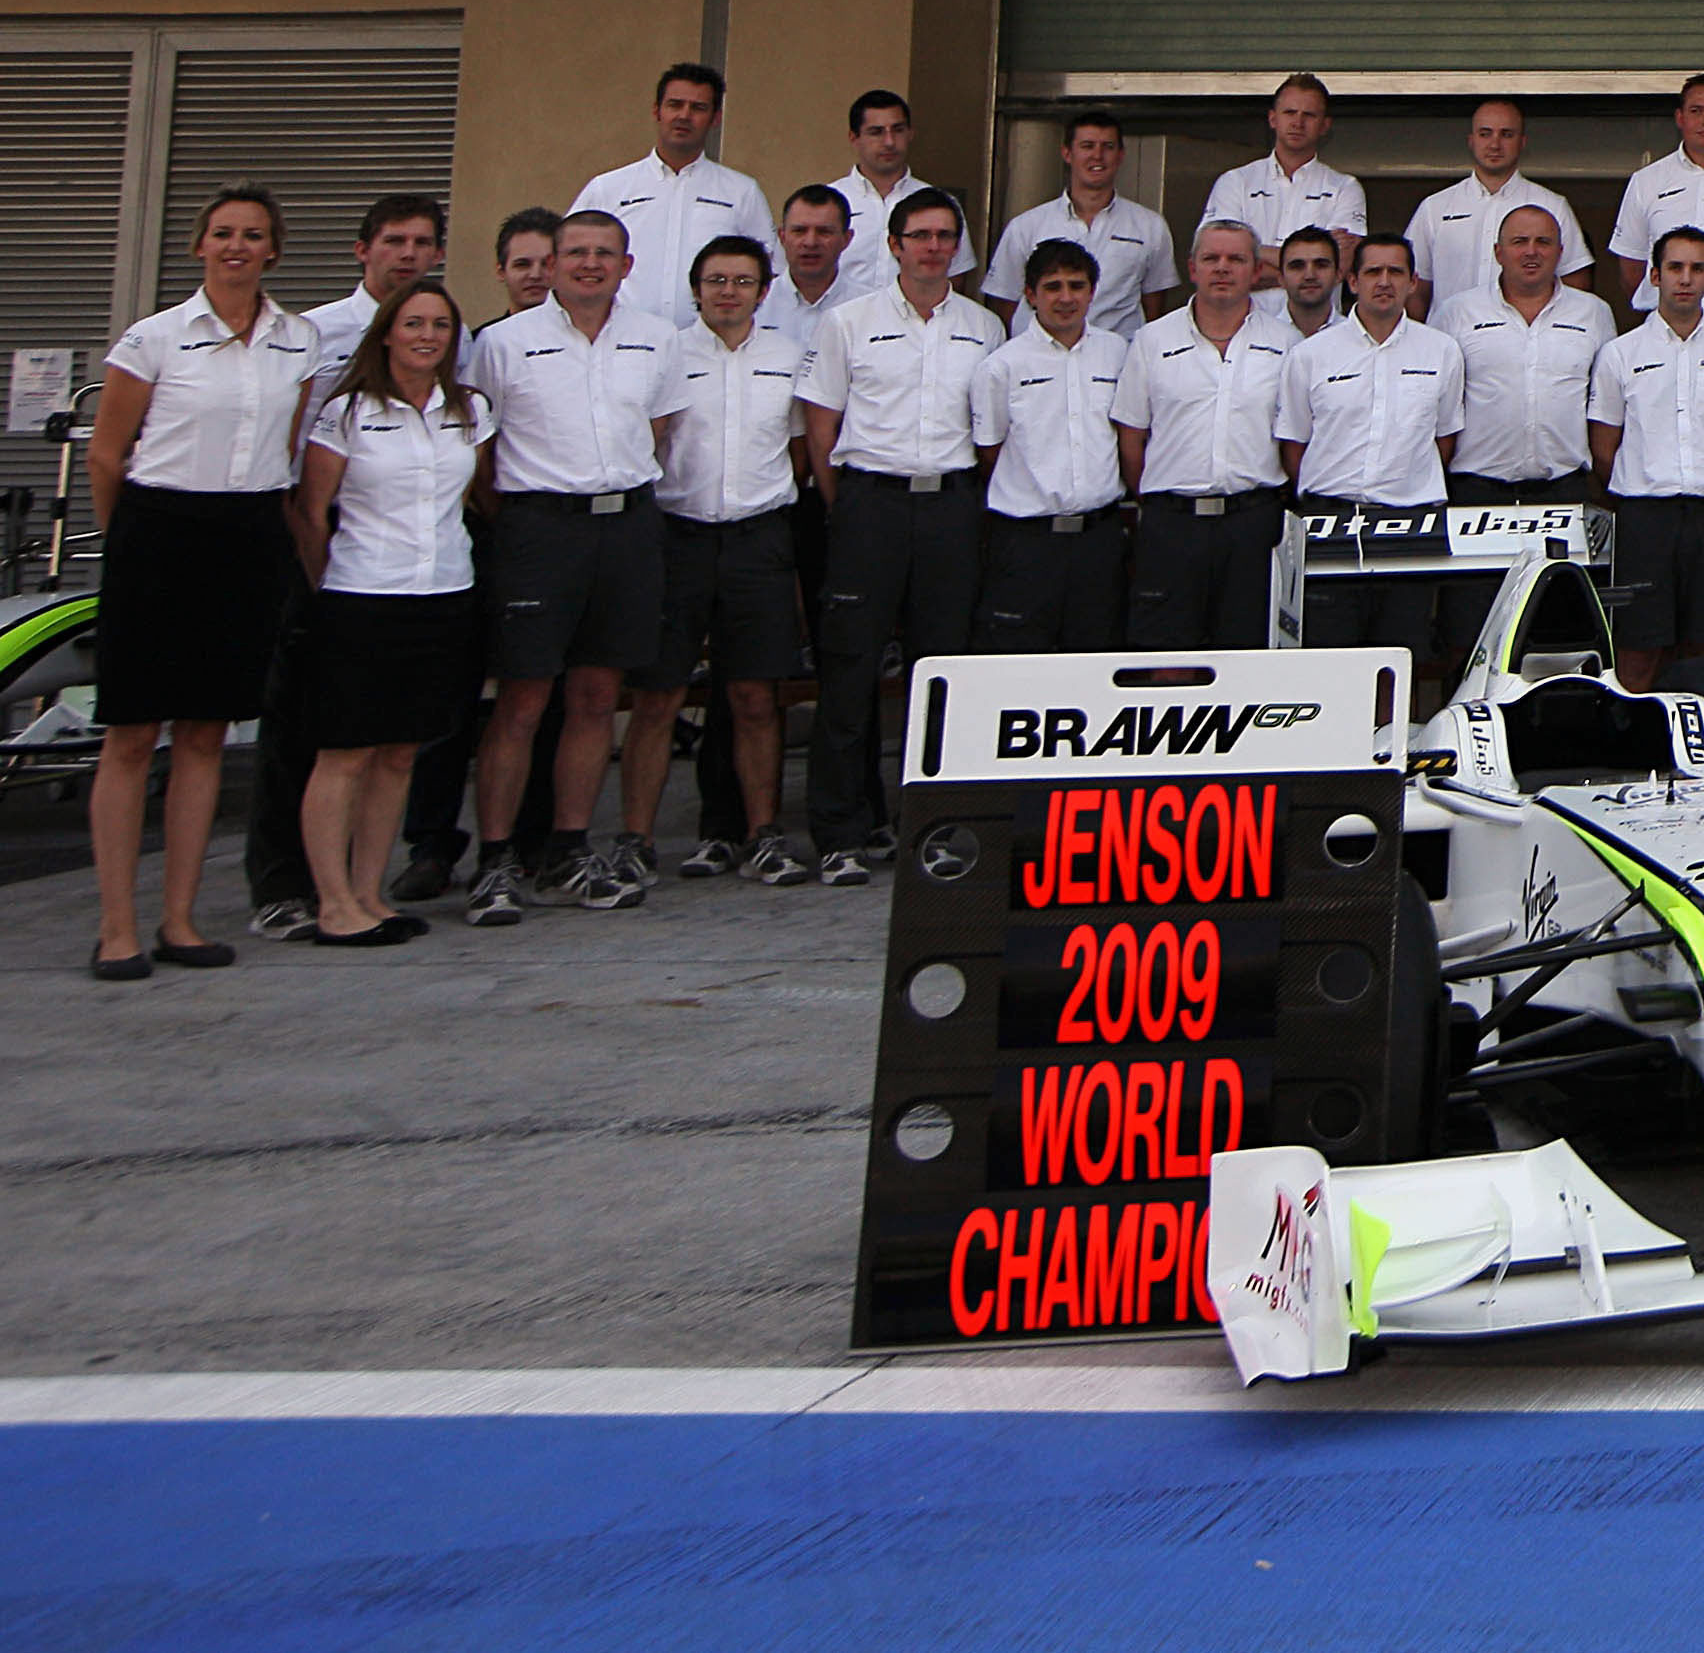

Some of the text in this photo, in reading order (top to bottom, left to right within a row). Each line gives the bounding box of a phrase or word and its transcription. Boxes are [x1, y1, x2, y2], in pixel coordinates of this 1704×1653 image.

[1024, 784, 1277, 909] JENSON
[1522, 843, 1560, 944] Virgin
[1057, 920, 1220, 1045] 2009
[1021, 1058, 1243, 1185] WORLD
